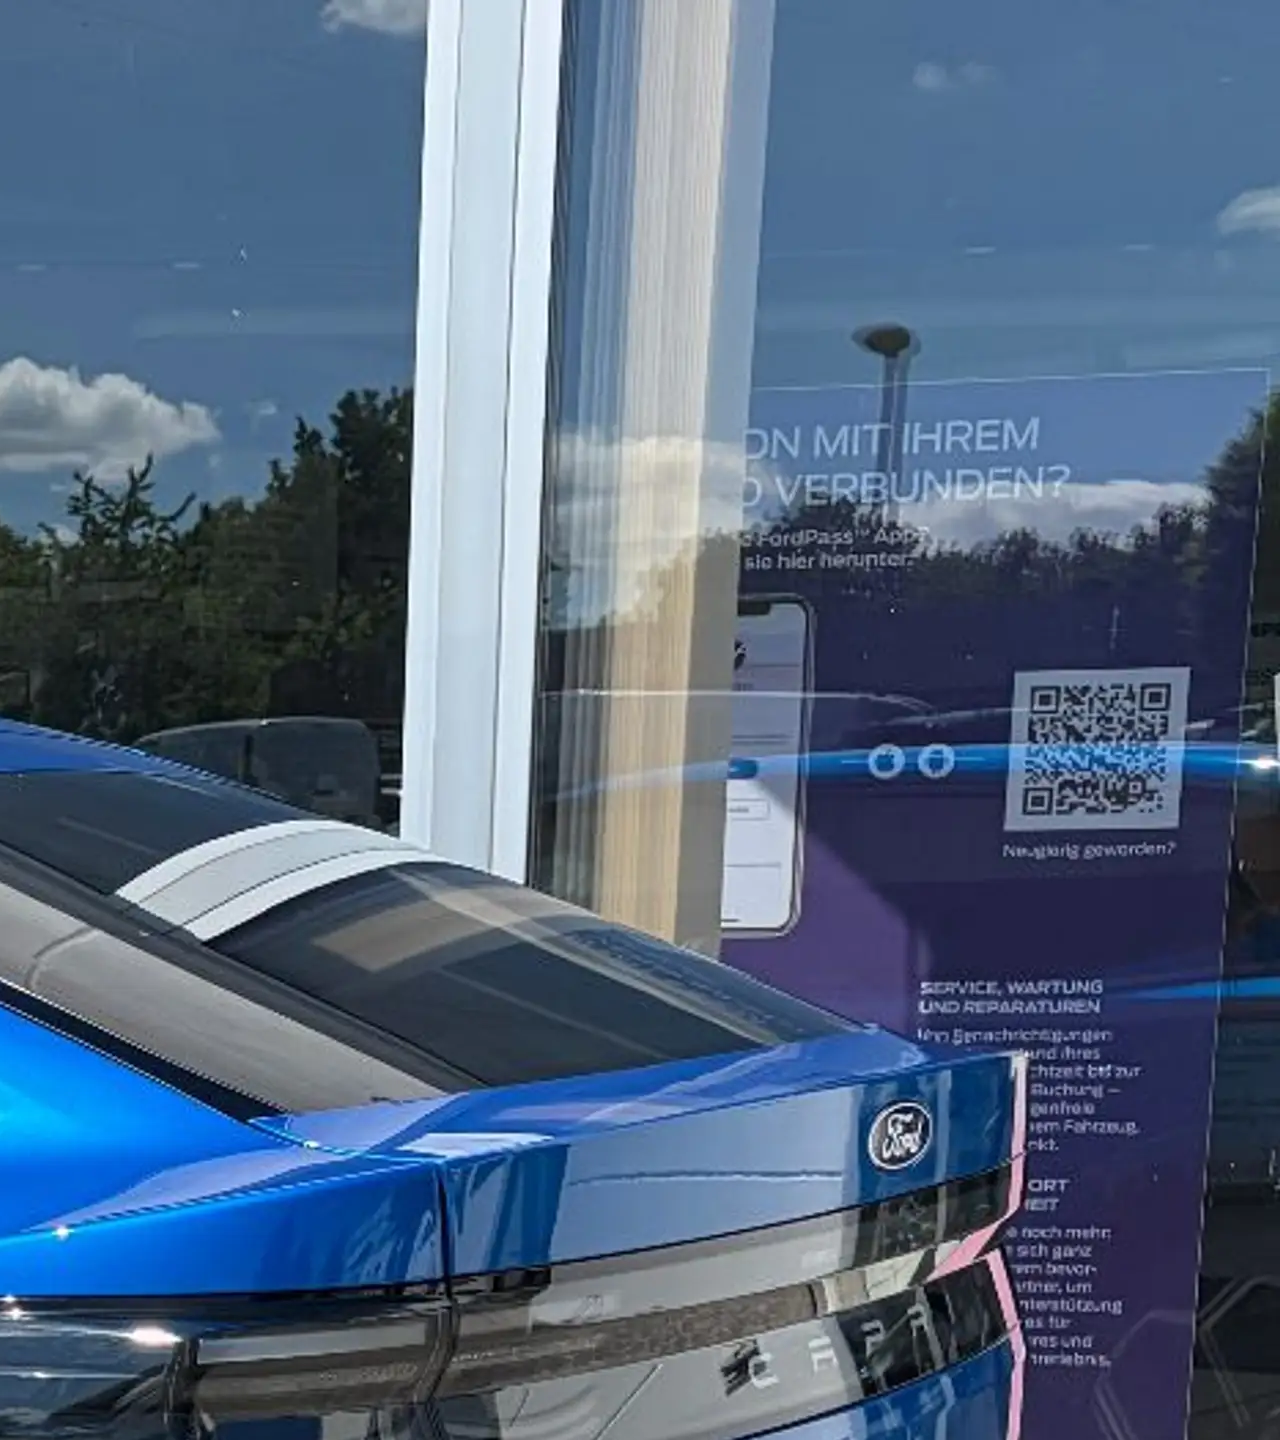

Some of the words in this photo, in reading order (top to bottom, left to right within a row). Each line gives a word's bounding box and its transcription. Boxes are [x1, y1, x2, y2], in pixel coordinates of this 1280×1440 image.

[813, 423, 892, 459] MIT
[901, 417, 1040, 456] IHREM
[775, 463, 1072, 508] VERBUNDEN?
[777, 552, 816, 570] hier
[919, 980, 1002, 997] SERVICE,
[1006, 978, 1104, 996] WARTUNG
[917, 999, 961, 1015] UND
[962, 998, 1102, 1015] REPARATUREN
